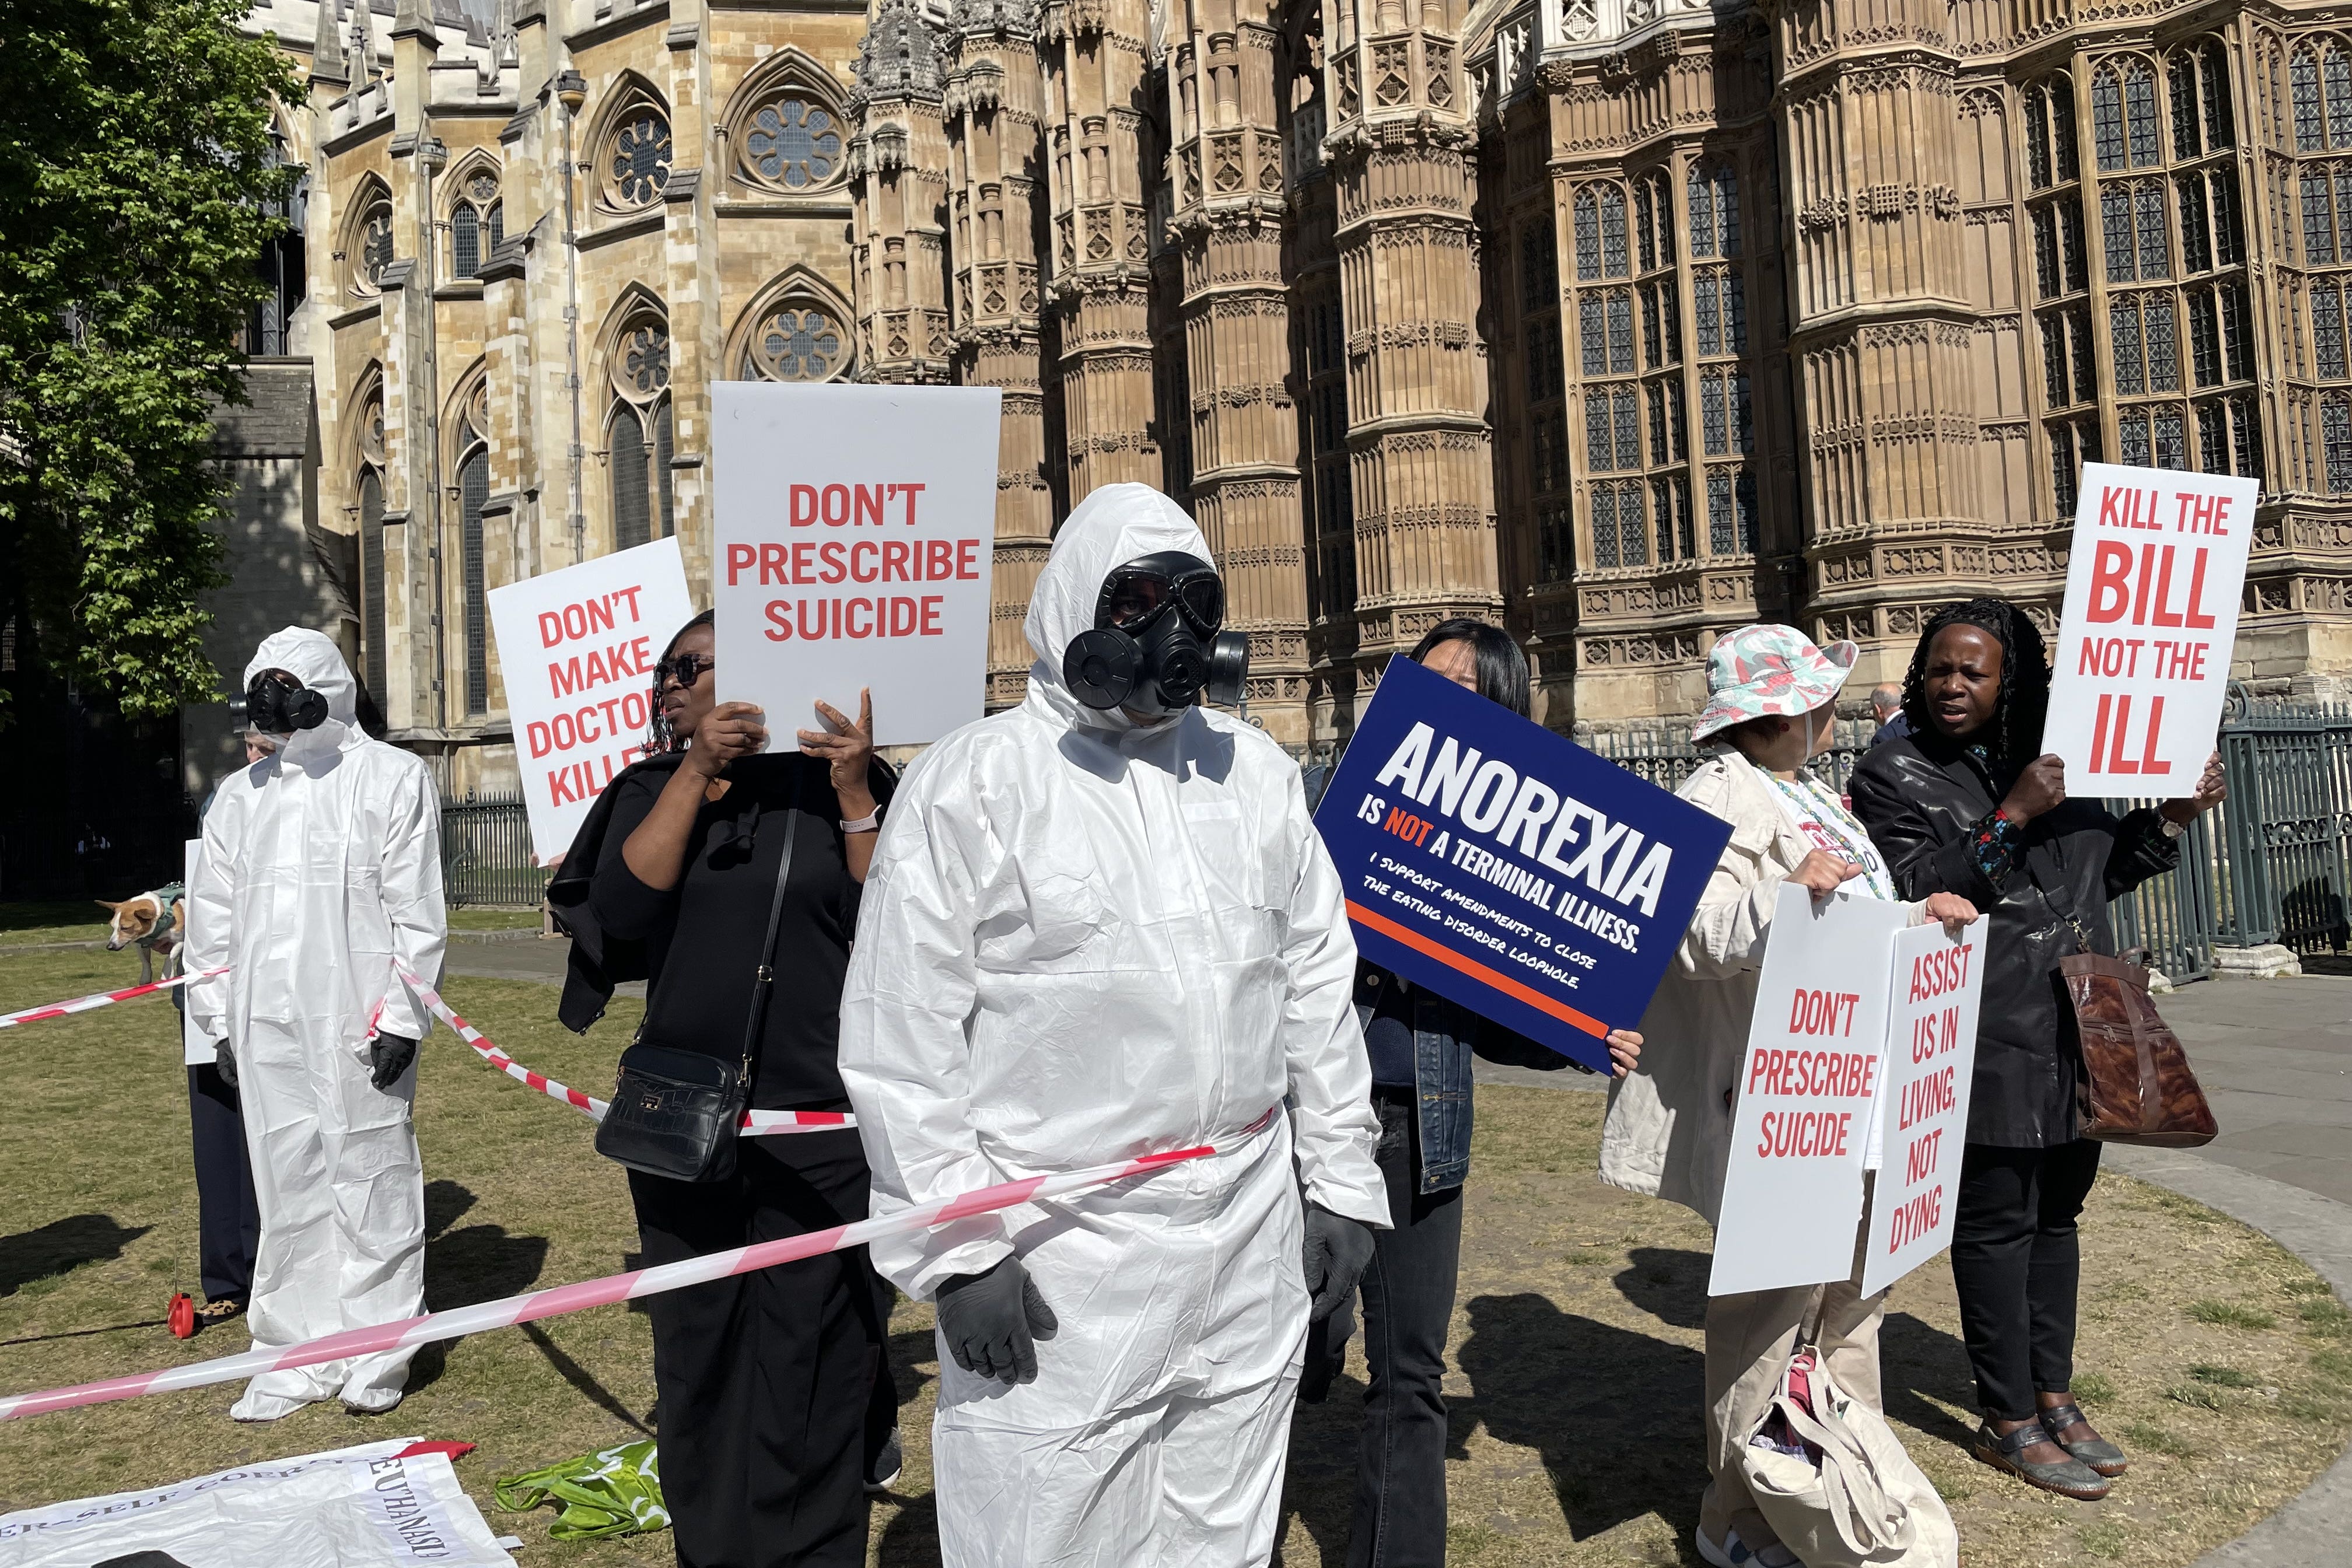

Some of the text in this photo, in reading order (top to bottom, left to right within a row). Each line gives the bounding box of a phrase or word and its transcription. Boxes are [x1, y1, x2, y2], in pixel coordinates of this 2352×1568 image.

[789, 483, 926, 527] DON'T
[2099, 485, 2233, 536] KILL THE
[727, 539, 980, 586] PRESCRIBE
[2085, 539, 2216, 629] BILL
[538, 584, 642, 649] DON'T
[764, 596, 944, 642] SUICIDE
[548, 635, 655, 699] MAKE
[2078, 636, 2210, 681] NOT THE
[2088, 694, 2172, 775] ILL
[1374, 721, 1673, 918] ANOREXIA
[1357, 793, 1640, 954] IS NOT A TERMINAL ILLNESS.
[1364, 874, 1580, 988] THE EATING DISORDER LOOPHOLE.
[1370, 852, 1597, 970] I SUPPORT AMENDMENTS TO CLOSE
[1909, 943, 1973, 1004] ASSIST
[1789, 988, 1860, 1037] DON'T
[1912, 1006, 1959, 1065] US IN
[1748, 1048, 1878, 1098] PRESCRIBE
[1899, 1066, 1956, 1132] LIVING,
[1758, 1111, 1852, 1158] SUICIDE
[1906, 1128, 1943, 1188] NOT
[1889, 1184, 1943, 1255] DYING
